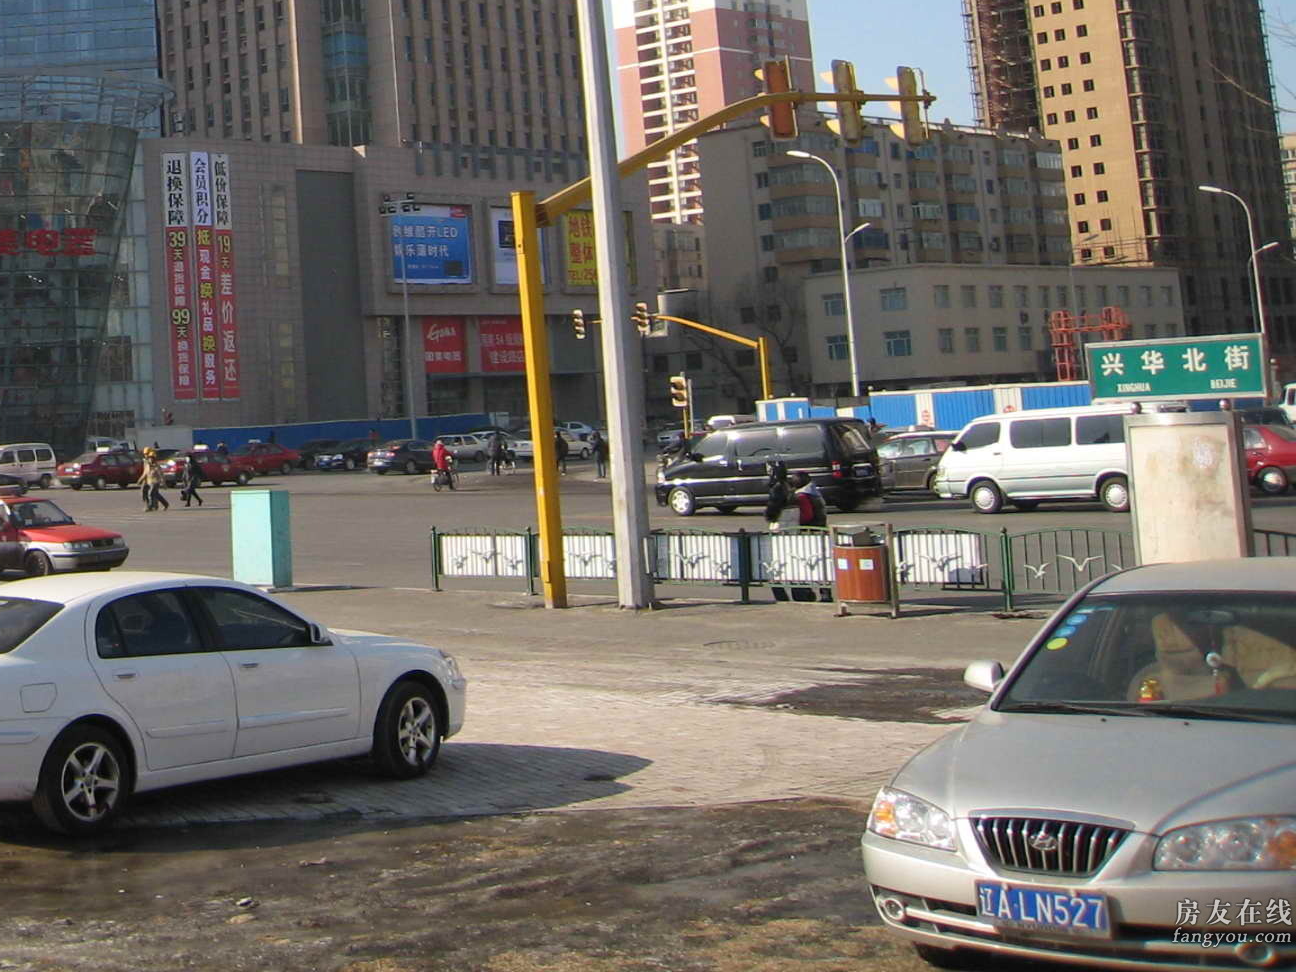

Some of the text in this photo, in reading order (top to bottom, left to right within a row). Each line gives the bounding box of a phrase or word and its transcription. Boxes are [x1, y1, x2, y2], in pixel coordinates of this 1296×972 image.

[166, 159, 184, 225] 退换保障
[194, 157, 209, 224] 会员积分
[215, 160, 229, 226] 低价保障
[218, 235, 237, 381] 19天差价返还
[1101, 345, 1249, 376] 兴华北街
[1116, 382, 1151, 393] XINGHUA
